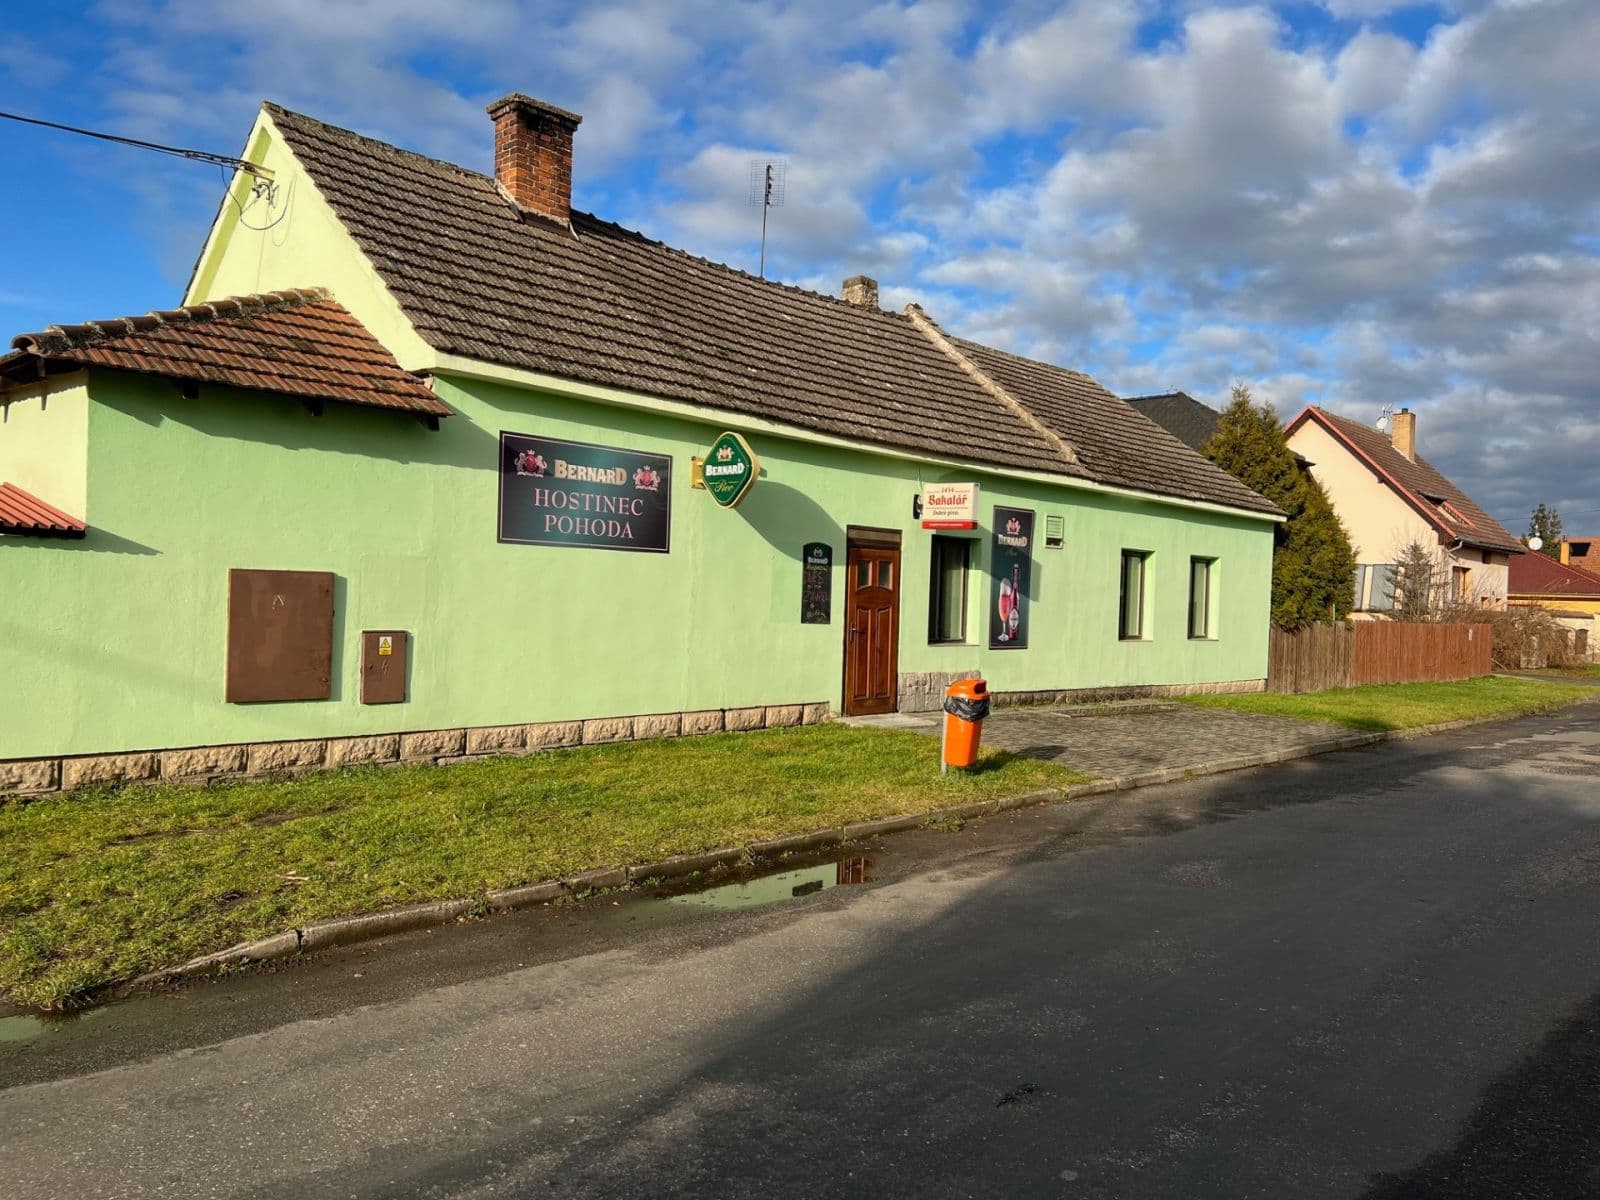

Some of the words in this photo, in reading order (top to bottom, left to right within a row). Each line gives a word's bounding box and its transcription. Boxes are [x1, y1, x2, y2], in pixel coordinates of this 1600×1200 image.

[554, 459, 627, 486] BERNARD
[705, 462, 745, 477] BERNARD
[534, 488, 644, 516] HOSTINEC
[544, 514, 634, 539] POHODA
[998, 534, 1028, 547] BERNARD
